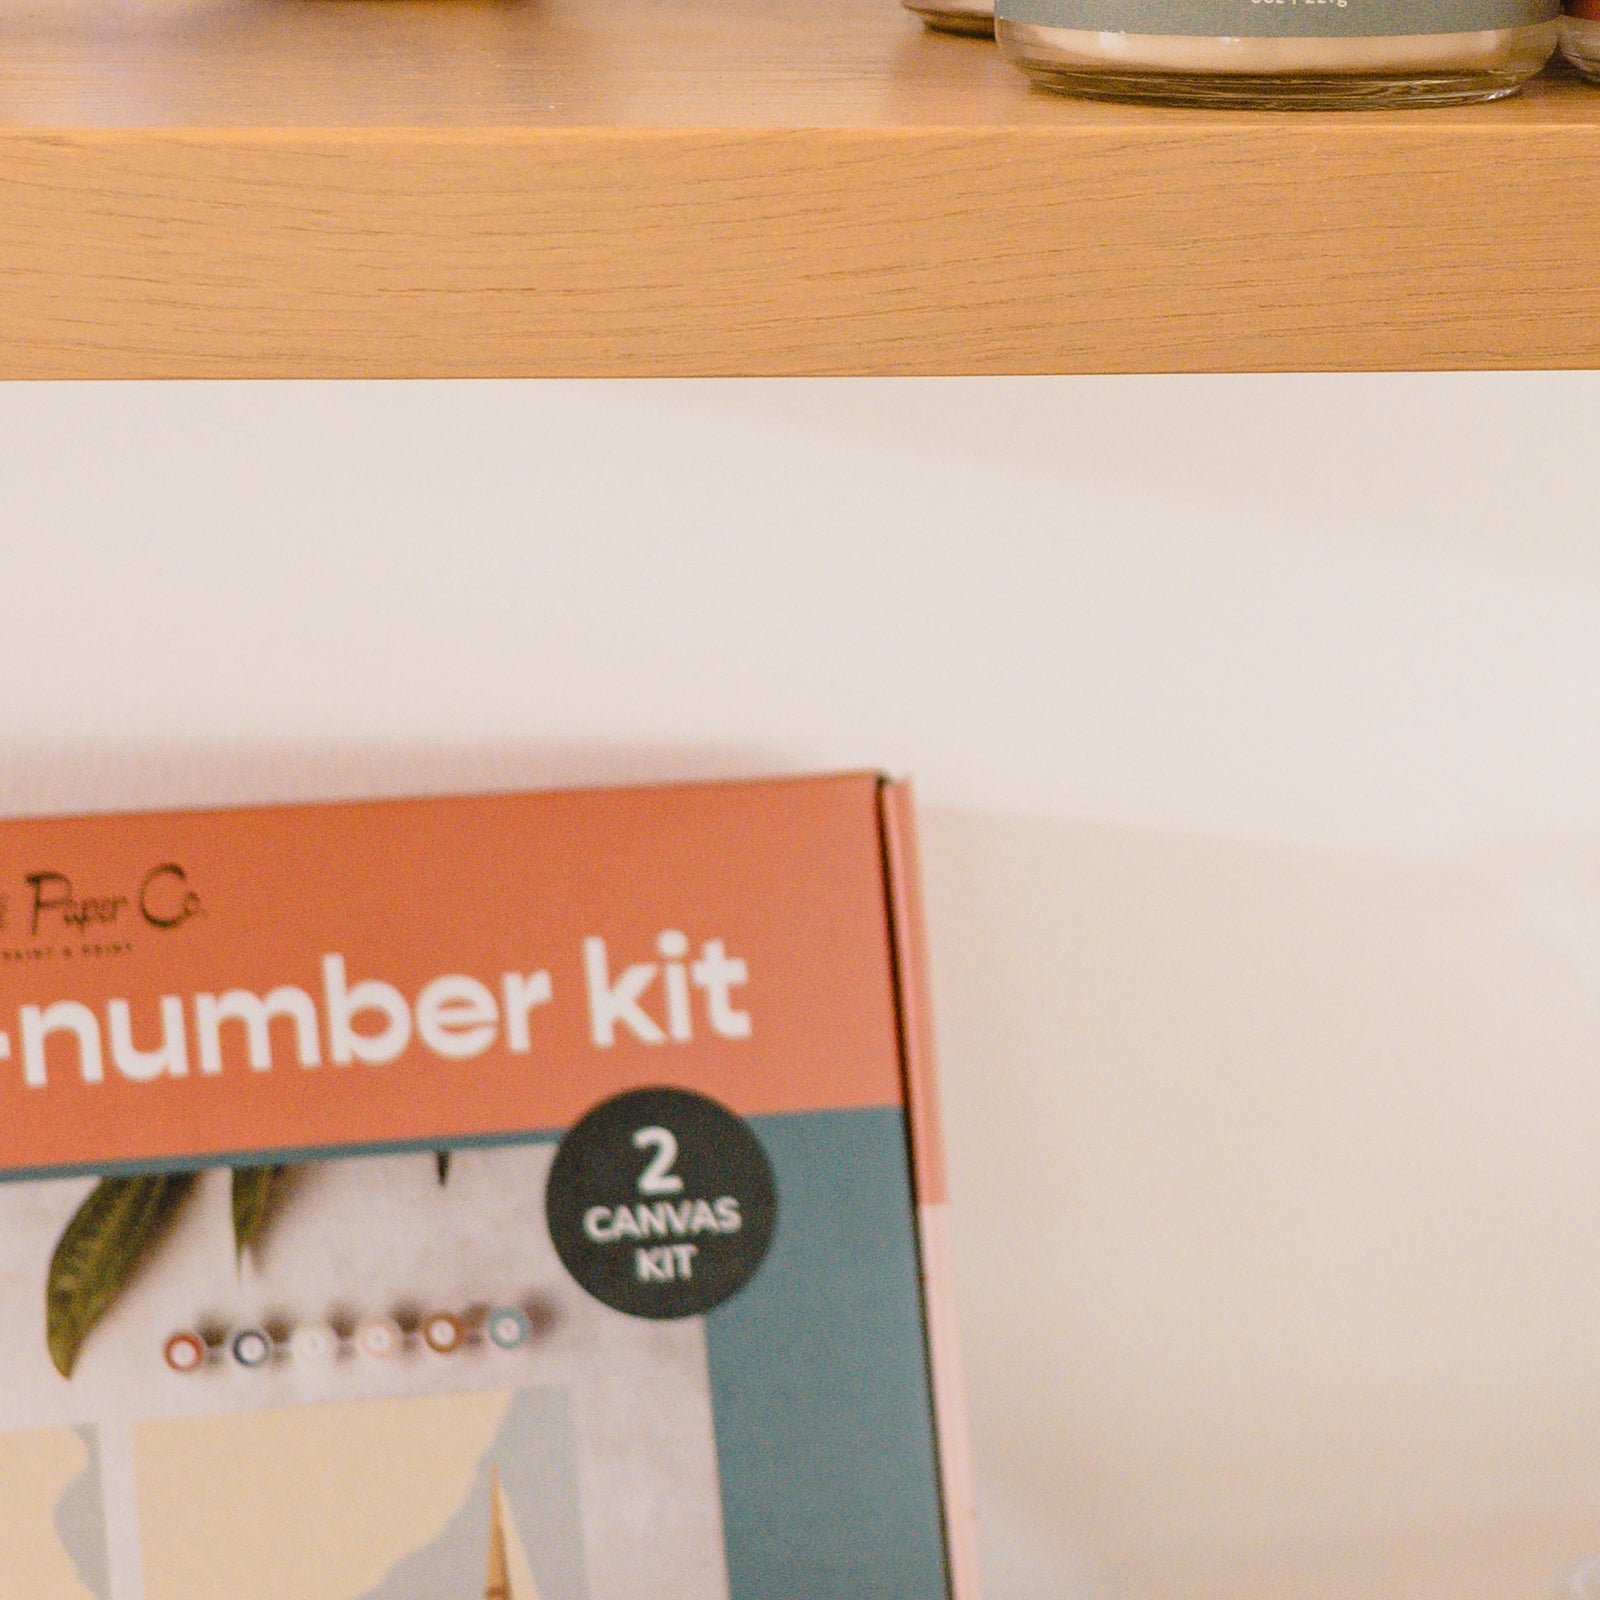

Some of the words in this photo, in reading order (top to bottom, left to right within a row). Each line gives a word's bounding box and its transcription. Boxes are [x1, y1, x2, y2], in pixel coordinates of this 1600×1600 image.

[584, 930, 751, 1047] kit
[634, 1127, 682, 1194] 2
[585, 1197, 741, 1243] CANVAS
[637, 1244, 695, 1280] KIT
